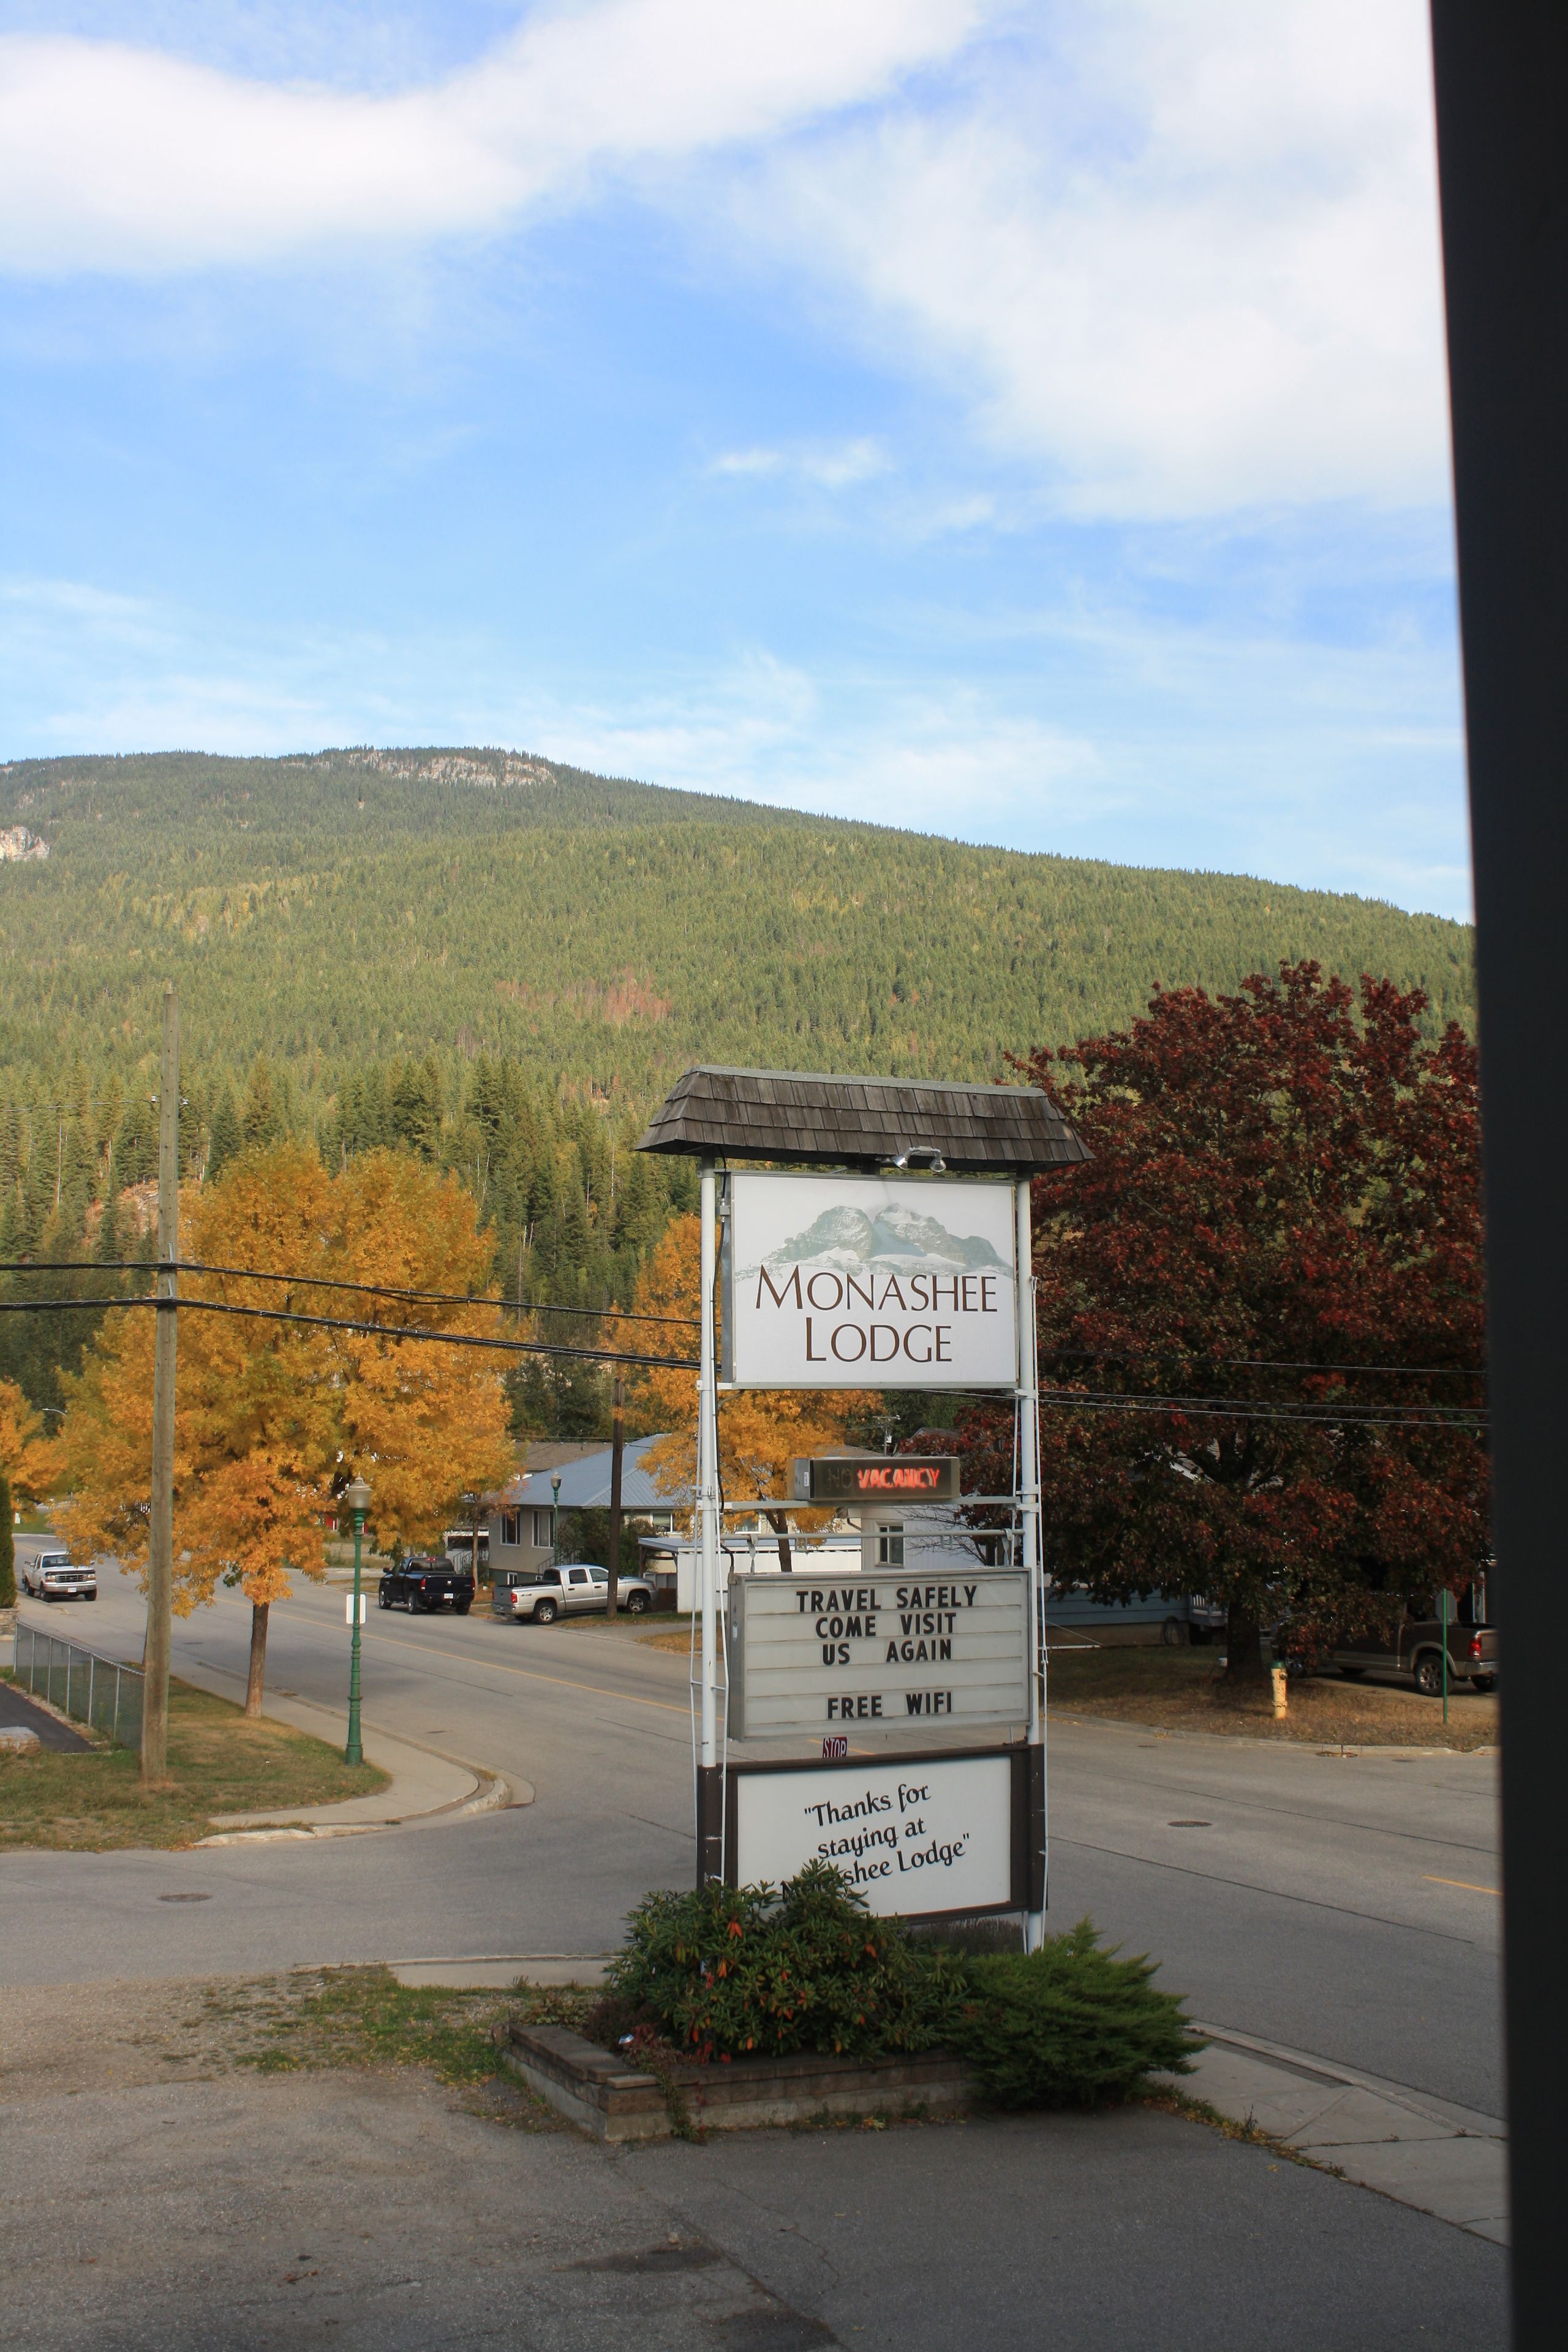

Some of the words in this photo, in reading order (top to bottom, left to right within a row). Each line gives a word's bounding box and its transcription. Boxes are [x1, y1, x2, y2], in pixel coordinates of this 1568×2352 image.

[756, 1264, 998, 1313] MONASHEE
[805, 1317, 952, 1363] LODGE
[858, 1468, 940, 1489] VACANCY
[796, 1588, 881, 1613] TRAVEL
[896, 1585, 978, 1609] SAFELY
[815, 1615, 876, 1639] COME
[900, 1612, 957, 1635] VISIT
[822, 1643, 850, 1666] US
[885, 1638, 951, 1662] AGAIN
[827, 1695, 883, 1719] FREE
[905, 1691, 952, 1715] WIFI
[823, 1737, 846, 1757] STOP
[804, 1790, 892, 1826] "Thanks
[898, 1783, 931, 1813] for
[818, 1826, 899, 1859] staying
[904, 1817, 927, 1838] at
[896, 1832, 970, 1872] Lodge"
